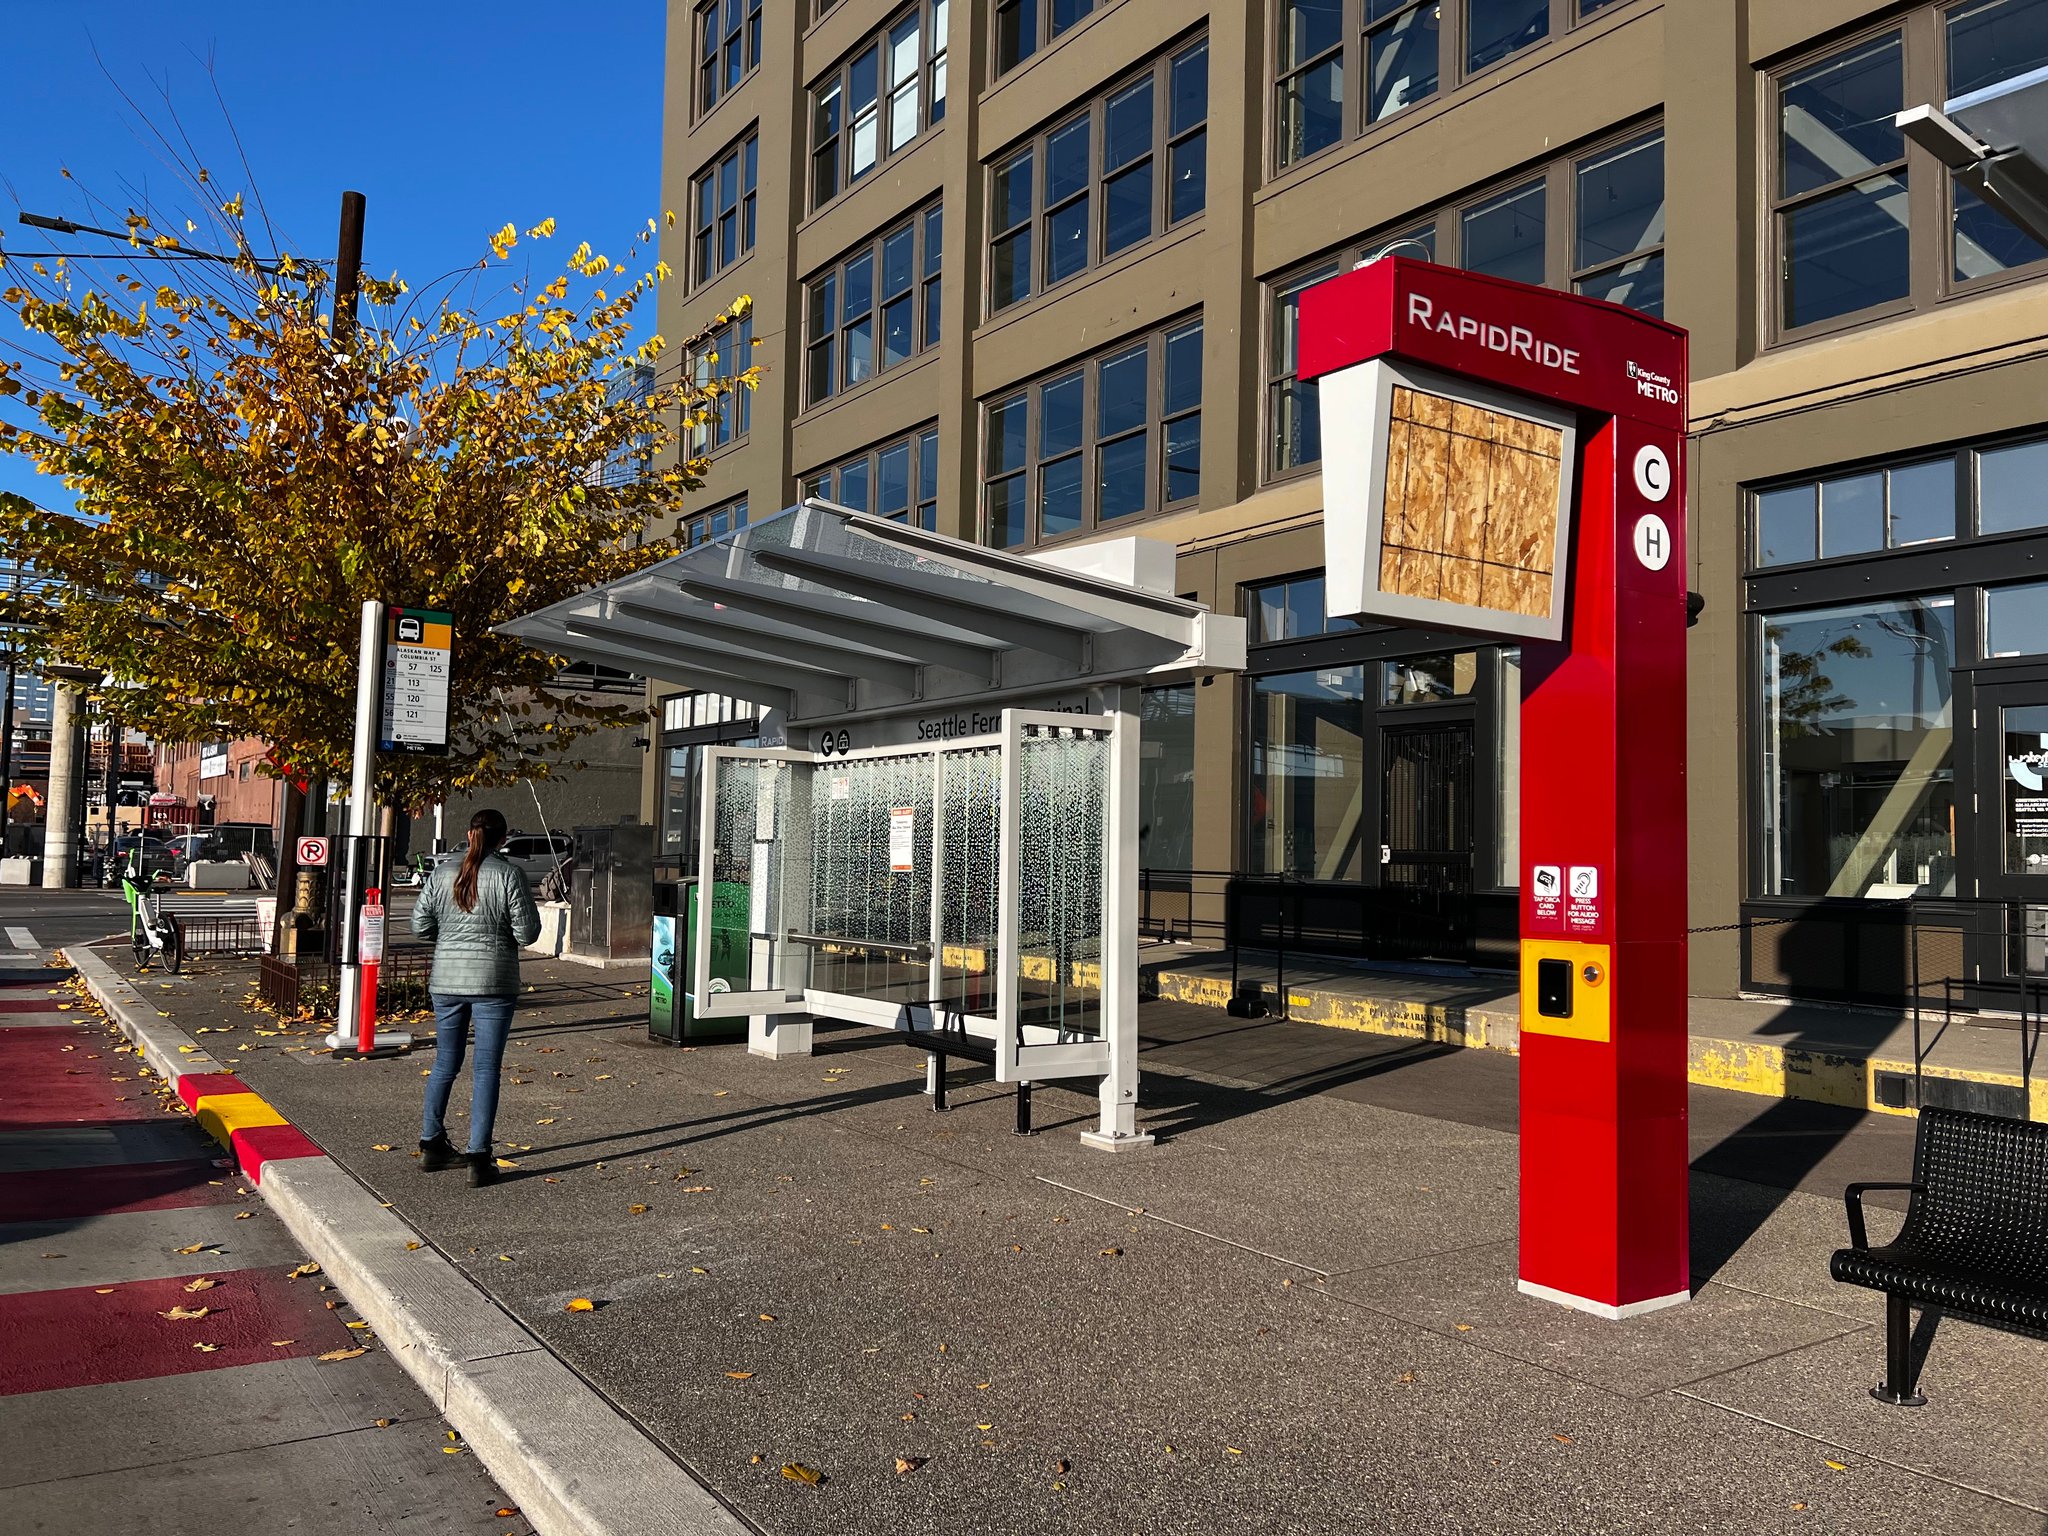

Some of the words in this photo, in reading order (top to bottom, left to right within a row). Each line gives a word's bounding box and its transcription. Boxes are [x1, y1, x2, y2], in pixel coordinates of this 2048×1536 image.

[1637, 368, 1650, 381] King
[1650, 372, 1671, 386] County
[1637, 379, 1679, 404] METRO
[1645, 458, 1660, 490] C
[1646, 526, 1661, 559] H
[396, 647, 422, 655] ALASKAN
[400, 653, 428, 661] COLUMBIA
[408, 662, 418, 671] 57
[429, 665, 442, 673] 125
[386, 677, 395, 685] 21
[407, 679, 420, 687] 113
[385, 693, 395, 701] 55
[407, 694, 420, 703] 120
[384, 709, 394, 717] 56
[406, 710, 418, 718] 121
[917, 713, 967, 740] Seattle
[972, 712, 1002, 734] Ferr
[1570, 917, 1596, 925] MESSAGE
